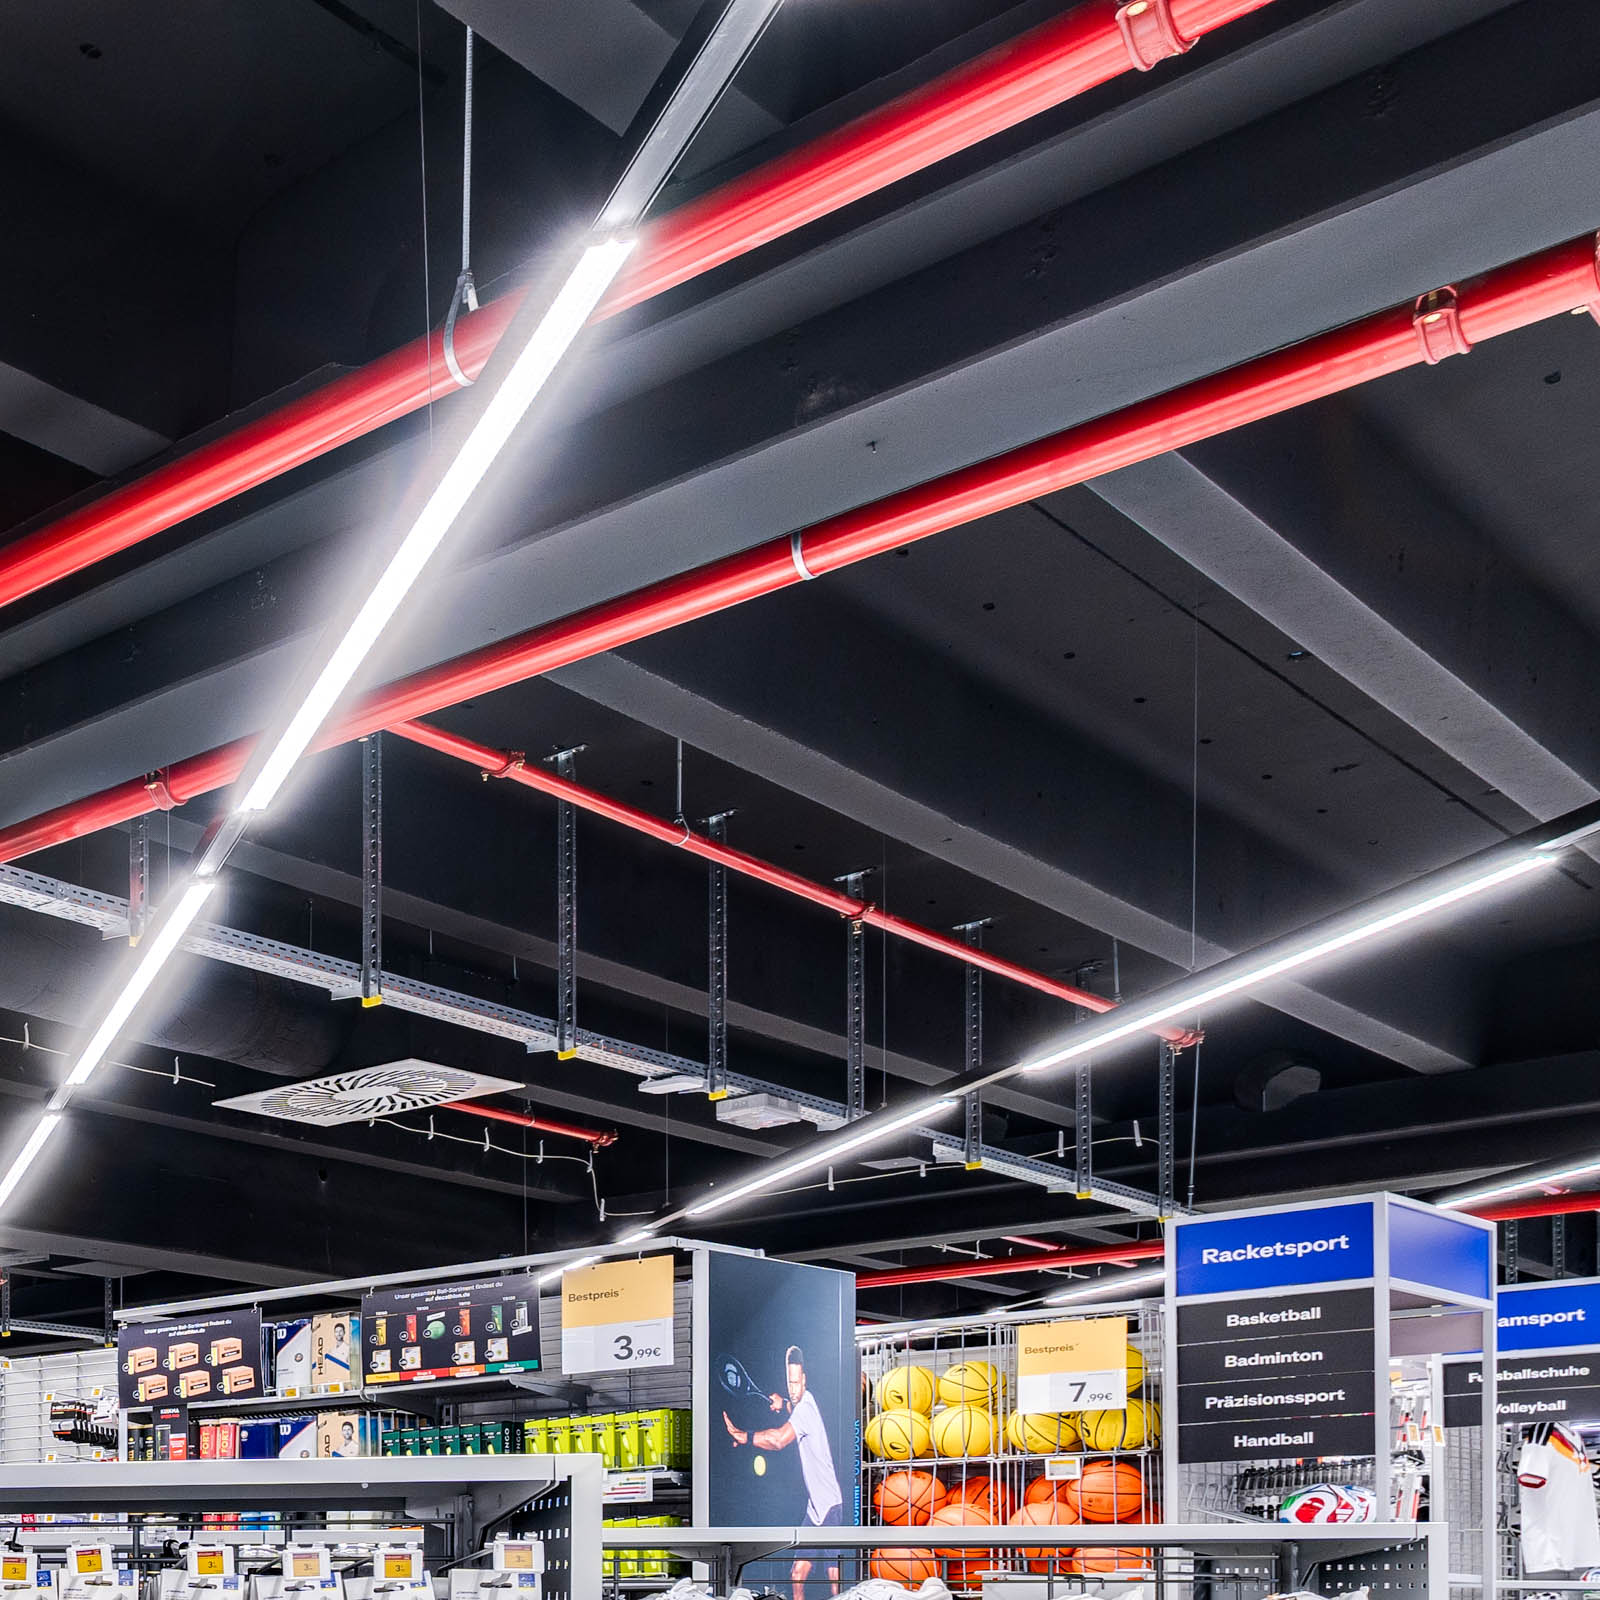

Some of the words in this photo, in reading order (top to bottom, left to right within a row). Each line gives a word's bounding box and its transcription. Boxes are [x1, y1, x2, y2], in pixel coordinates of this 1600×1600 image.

[1202, 1234, 1350, 1265] Racketsport
[568, 1289, 620, 1303] Bestpreis
[1226, 1306, 1322, 1327] Basketball
[1497, 1308, 1586, 1327] amsport
[613, 1335, 661, 1361] 3,99€
[1024, 1344, 1074, 1355] Bestpreis
[1224, 1350, 1324, 1368] Badminton
[1468, 1366, 1590, 1383] Fusballschuhe
[1205, 1388, 1346, 1409] Präzisionssport
[1233, 1431, 1314, 1448] Handball
